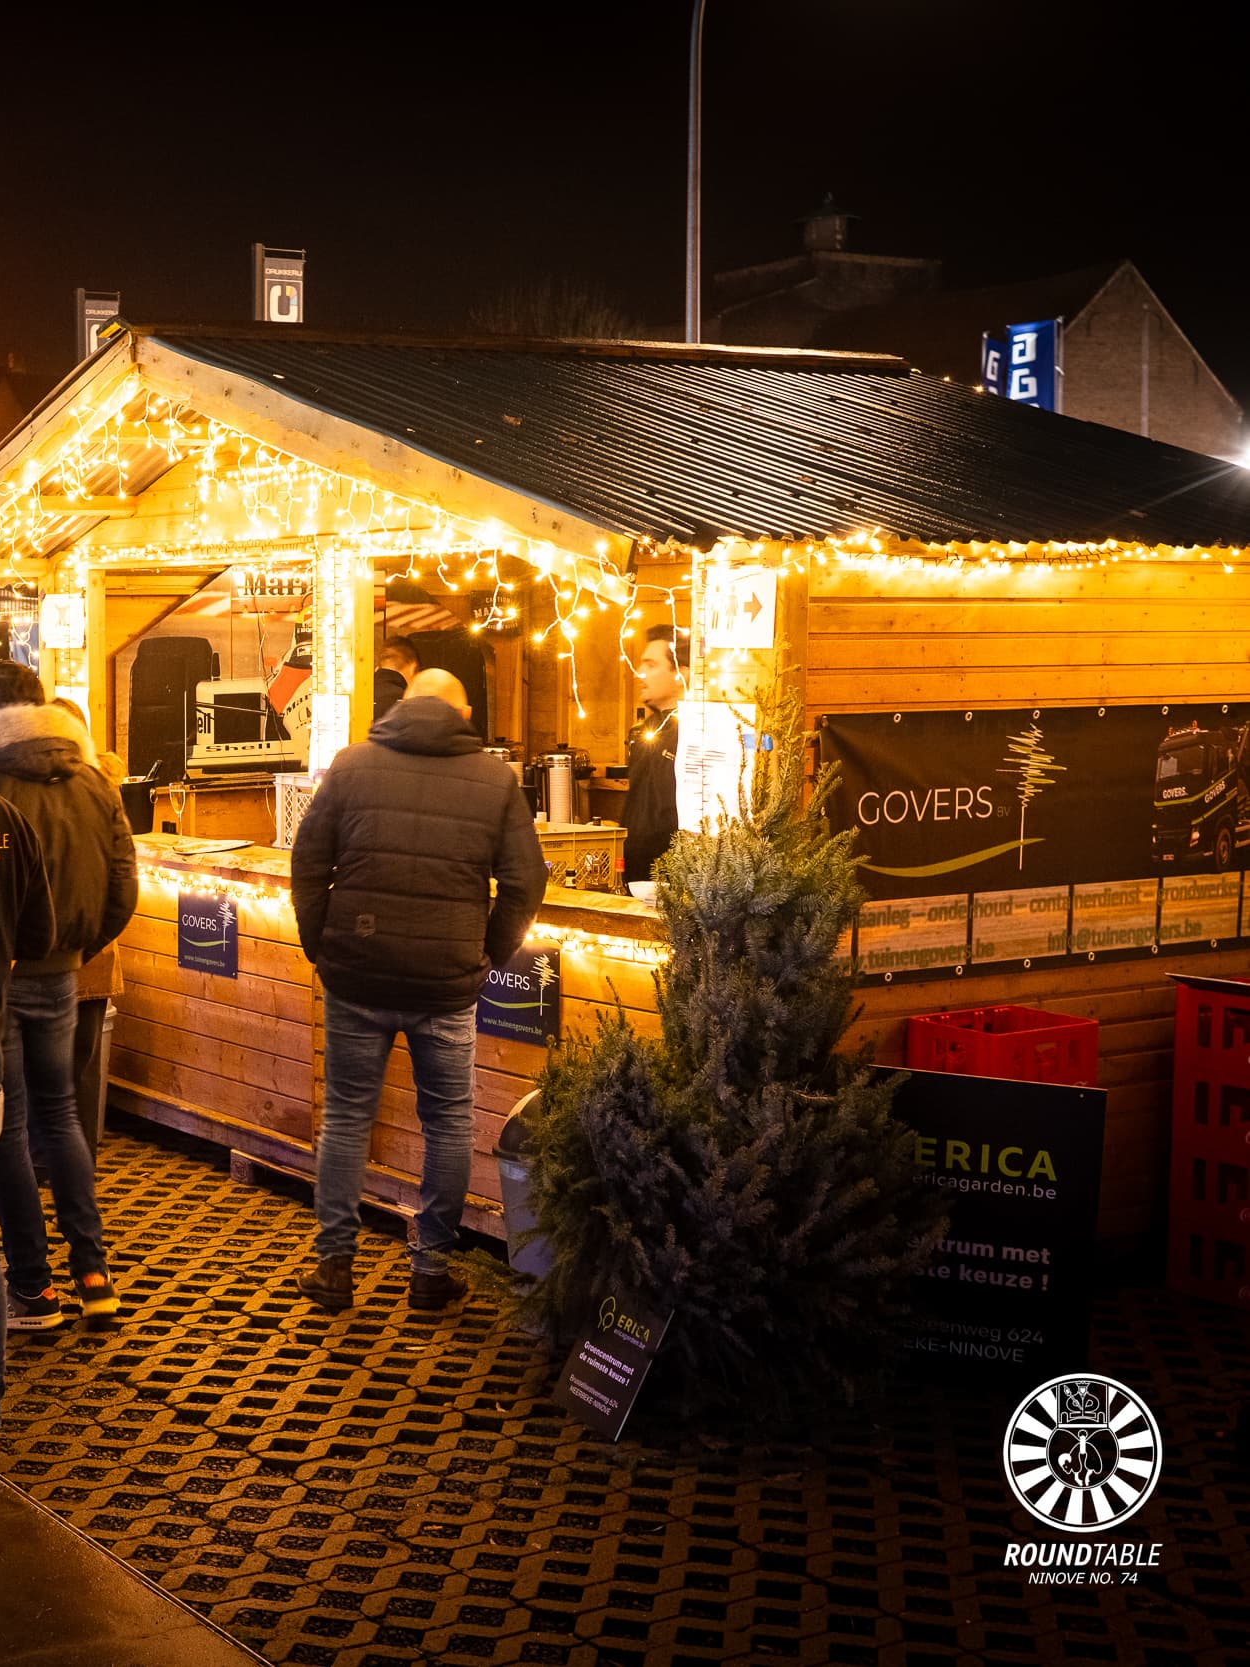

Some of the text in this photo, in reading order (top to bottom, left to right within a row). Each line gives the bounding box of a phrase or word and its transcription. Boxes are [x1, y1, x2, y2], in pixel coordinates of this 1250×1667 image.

[197, 708, 211, 735] ell
[206, 741, 271, 753] Shell
[858, 786, 993, 825] GOVERS
[182, 914, 217, 931] GOVERS
[486, 969, 530, 991] OVERS
[482, 1016, 543, 1036] www.tuinengovers.be
[913, 1136, 1058, 1182] ERICA
[912, 1171, 1057, 1200] ericagarden.be
[1001, 1246, 1051, 1266] met
[958, 1263, 1034, 1291] keuze
[616, 1314, 651, 1342] ERICA
[1006, 1328, 1045, 1345] 624
[578, 1351, 587, 1362] de
[584, 1340, 622, 1369] Groencentrum
